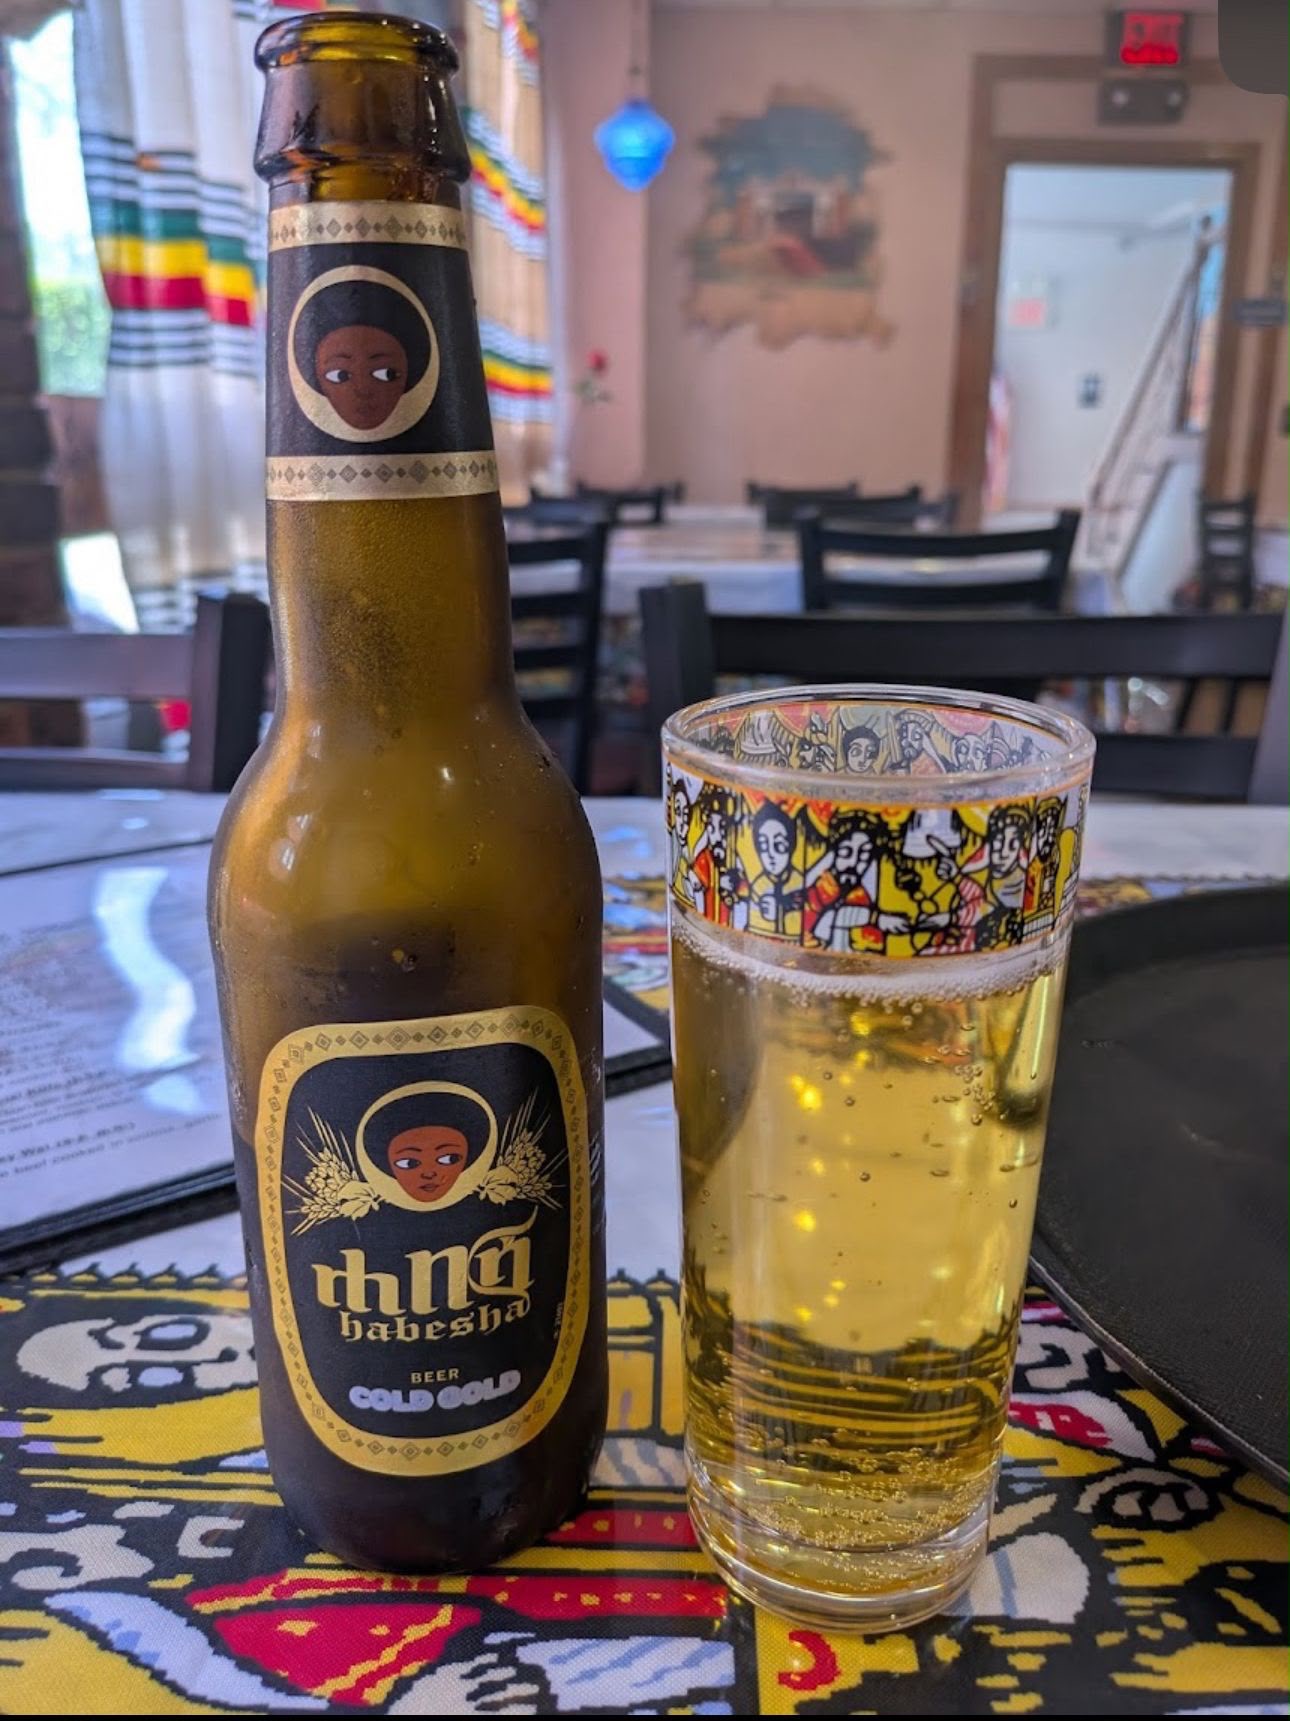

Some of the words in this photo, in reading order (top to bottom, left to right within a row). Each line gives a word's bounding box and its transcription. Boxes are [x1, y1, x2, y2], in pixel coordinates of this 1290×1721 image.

[340, 1300, 531, 1342] habesha
[410, 1367, 460, 1384] BEER
[349, 1385, 434, 1412] COLD
